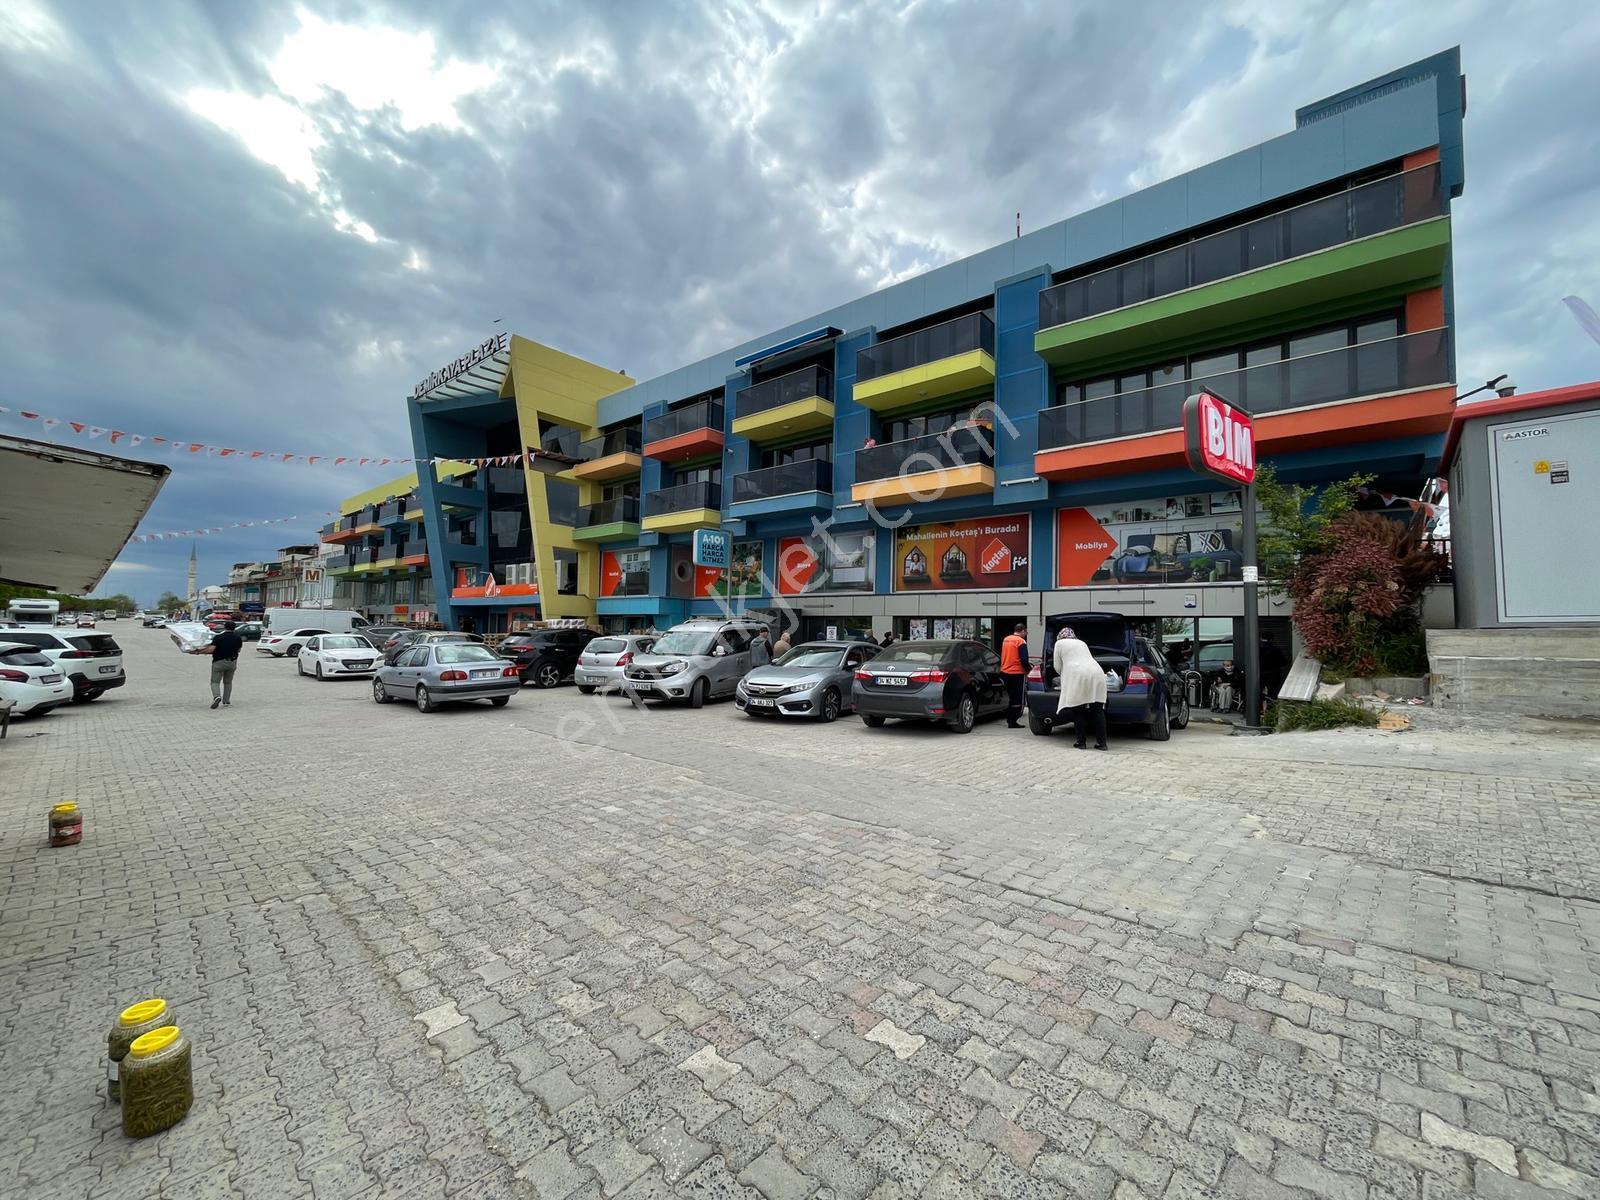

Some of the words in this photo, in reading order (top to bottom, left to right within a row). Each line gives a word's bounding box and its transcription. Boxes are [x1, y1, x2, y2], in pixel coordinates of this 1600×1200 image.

[463, 333, 507, 371] PLAZA
[1207, 403, 1253, 470] BİM
[906, 531, 948, 542] Mahallenin
[949, 527, 983, 539] Koçtaş'ı
[985, 523, 1020, 535] Burada!
[702, 543, 725, 552] HARCA
[702, 550, 725, 558] HARCA
[1075, 542, 1108, 551] Mobilya
[983, 545, 1011, 572] koçtaş
